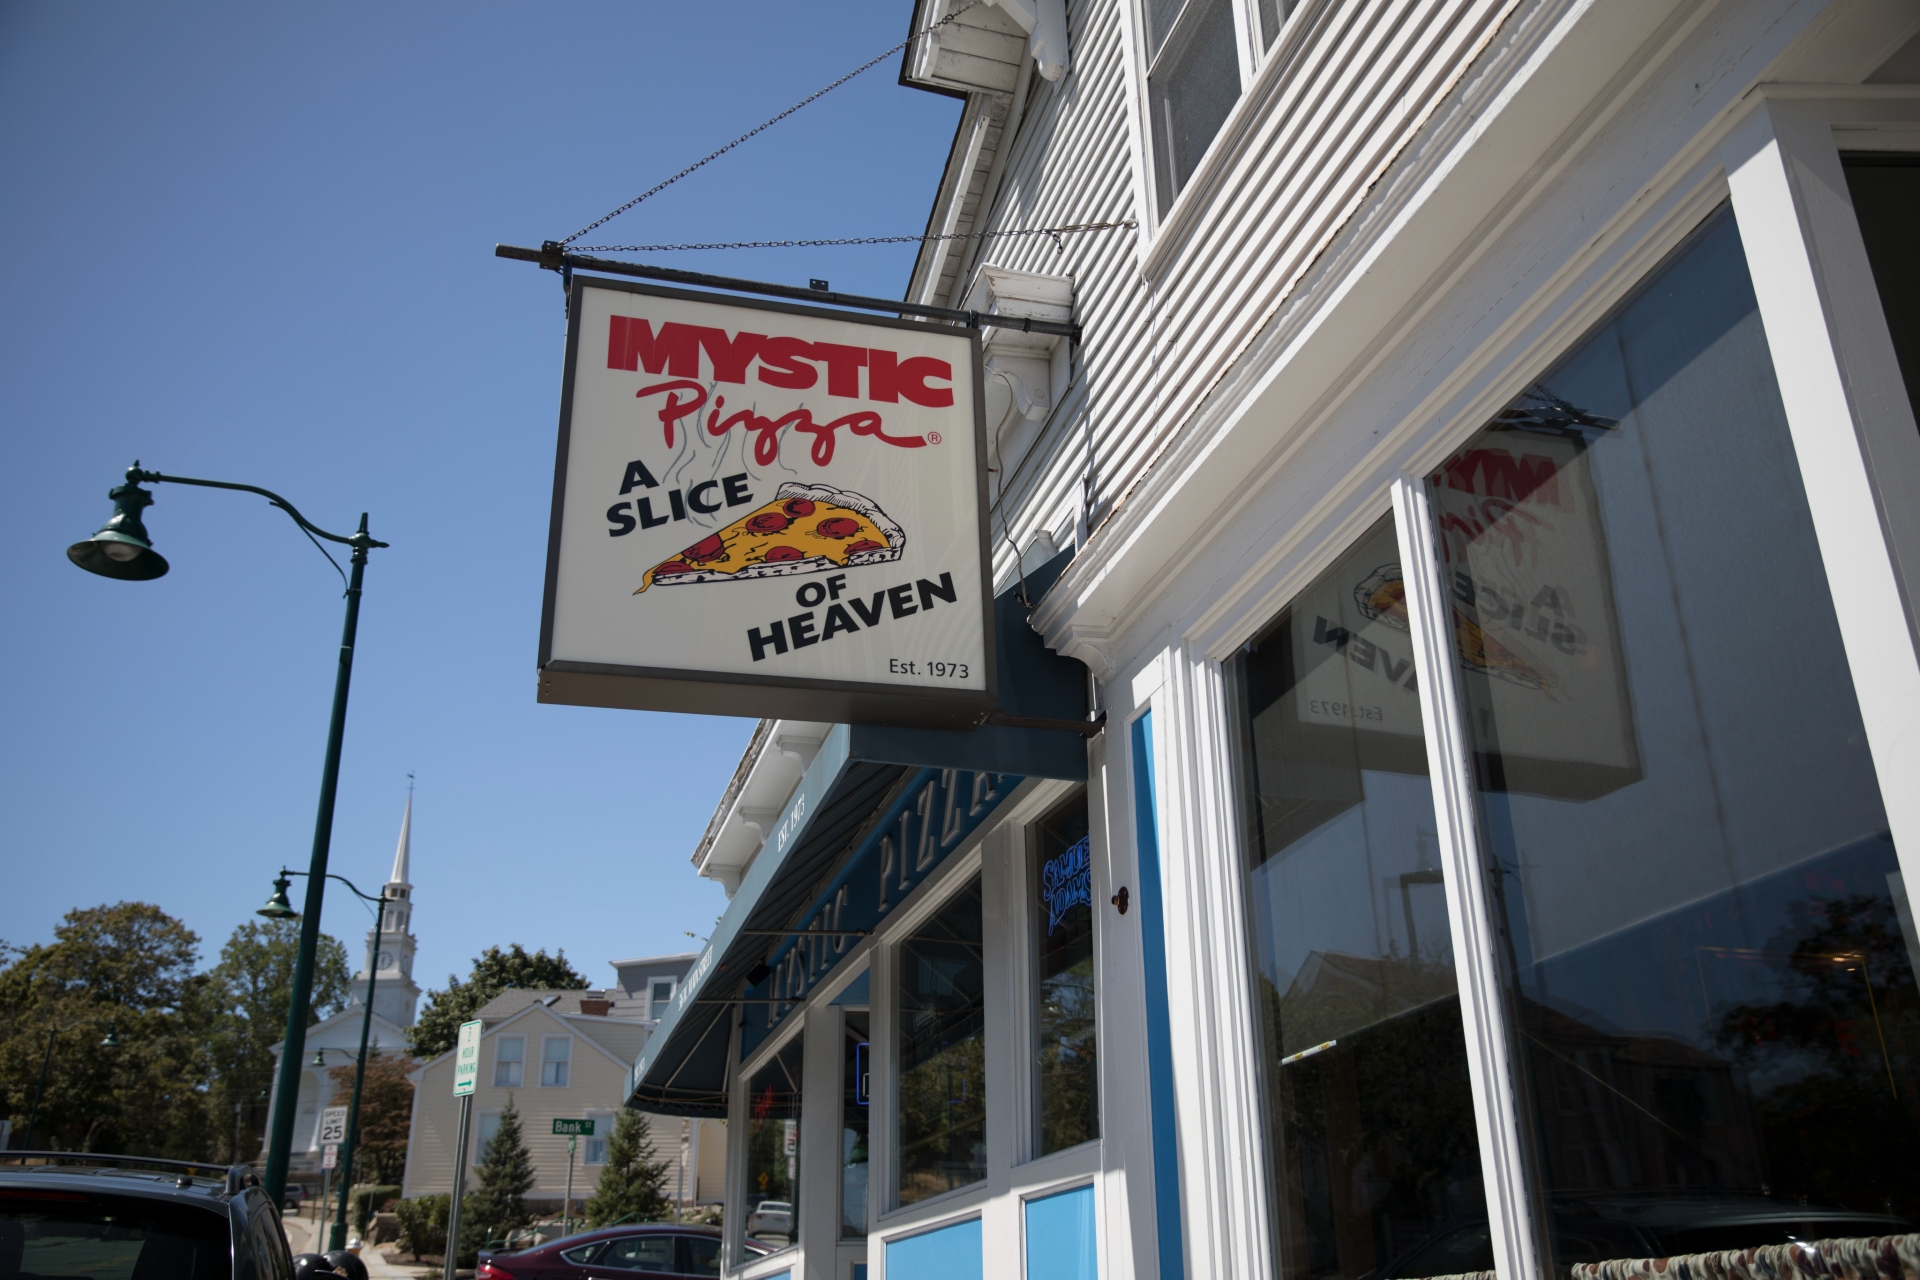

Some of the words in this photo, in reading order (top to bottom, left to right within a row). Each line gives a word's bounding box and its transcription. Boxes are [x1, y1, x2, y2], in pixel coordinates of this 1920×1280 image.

[606, 314, 955, 408] MYSTIC
[635, 379, 928, 467] Pizza
[618, 459, 660, 496] A
[605, 472, 754, 538] SLICE
[795, 573, 847, 608] OF
[746, 571, 958, 662] HEAVEN
[888, 658, 921, 676] Est.
[926, 660, 969, 679] 1973
[777, 819, 790, 853] EST.
[790, 792, 805, 832] 1973
[325, 1109, 346, 1118] SPEED
[326, 1117, 343, 1125] LIMIT
[555, 1120, 582, 1133] Bank
[323, 1125, 343, 1140] 25
